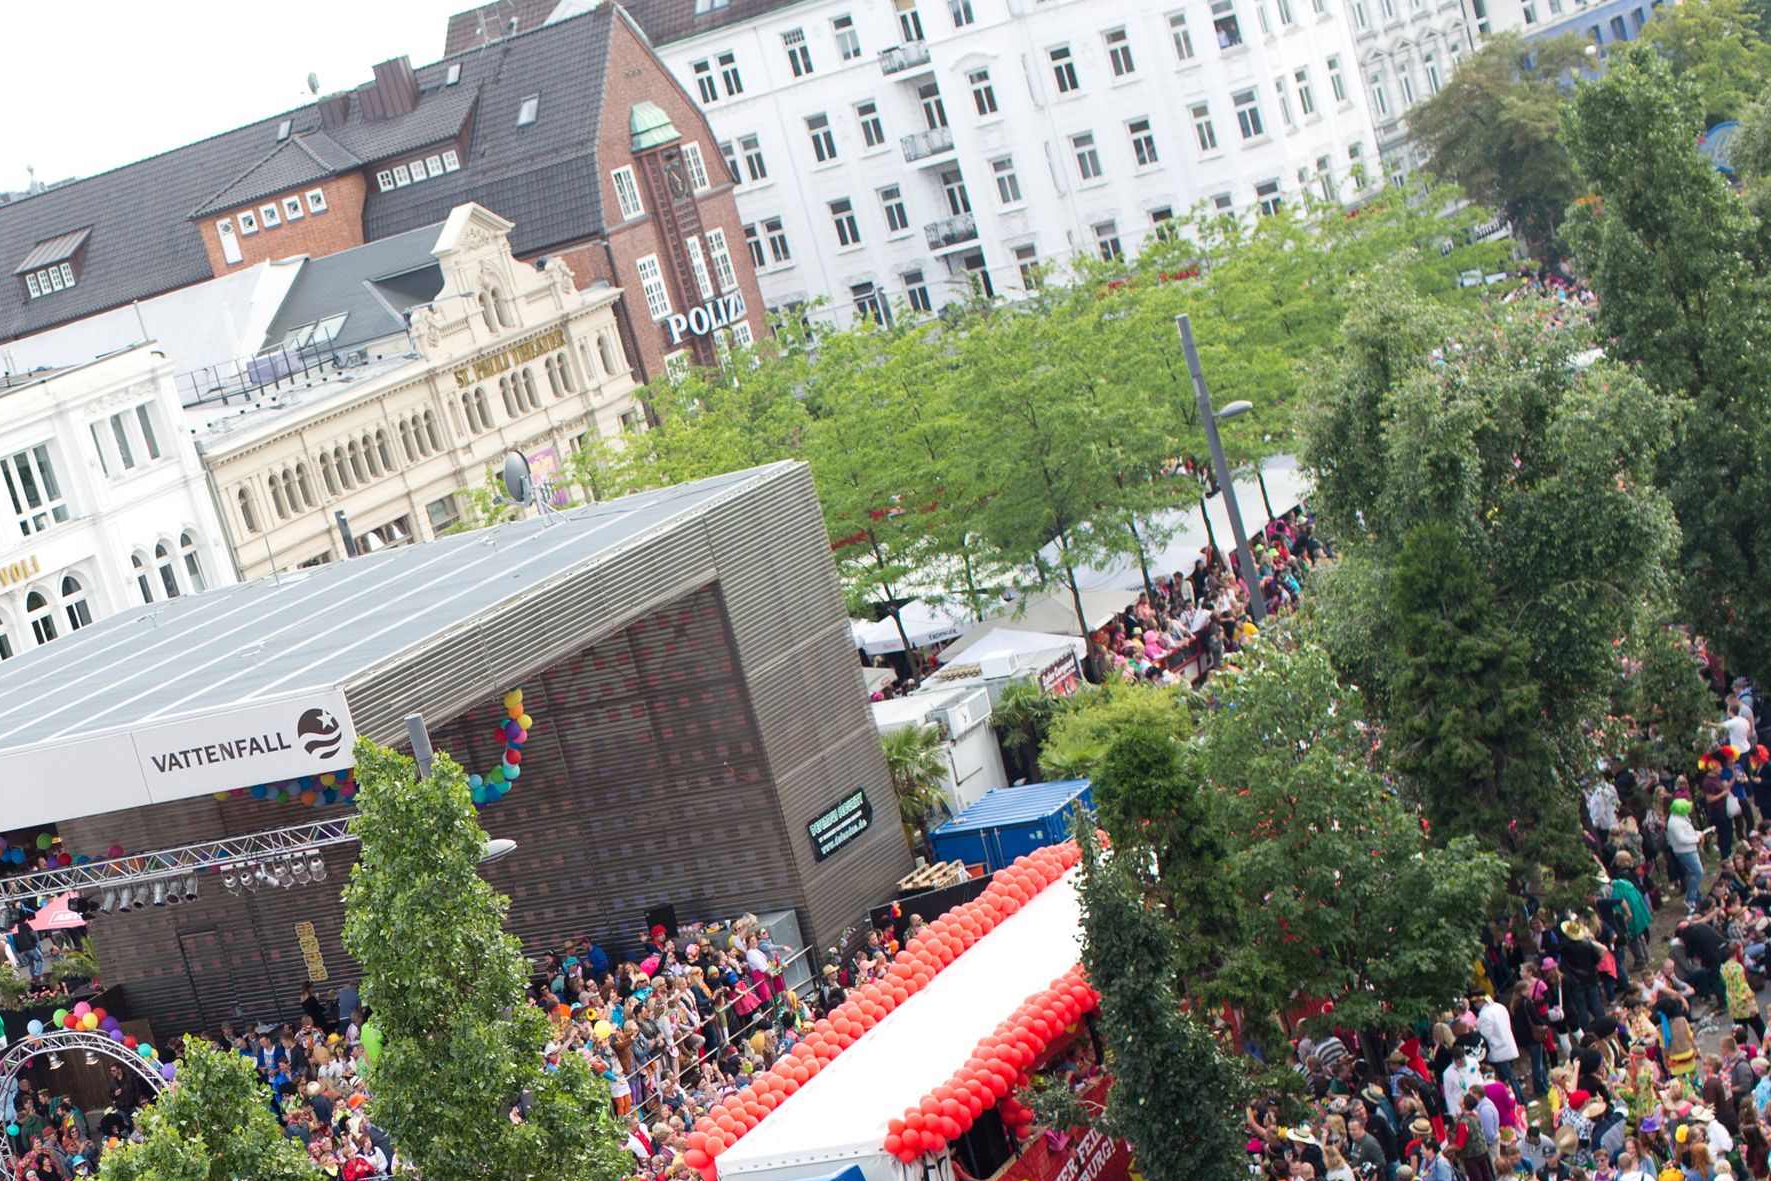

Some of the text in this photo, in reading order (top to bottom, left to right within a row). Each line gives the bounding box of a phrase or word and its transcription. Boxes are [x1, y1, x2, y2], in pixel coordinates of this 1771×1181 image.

[510, 328, 568, 367] THEATER
[151, 732, 292, 774] VATTENFALL
[53, 911, 84, 923] AST
